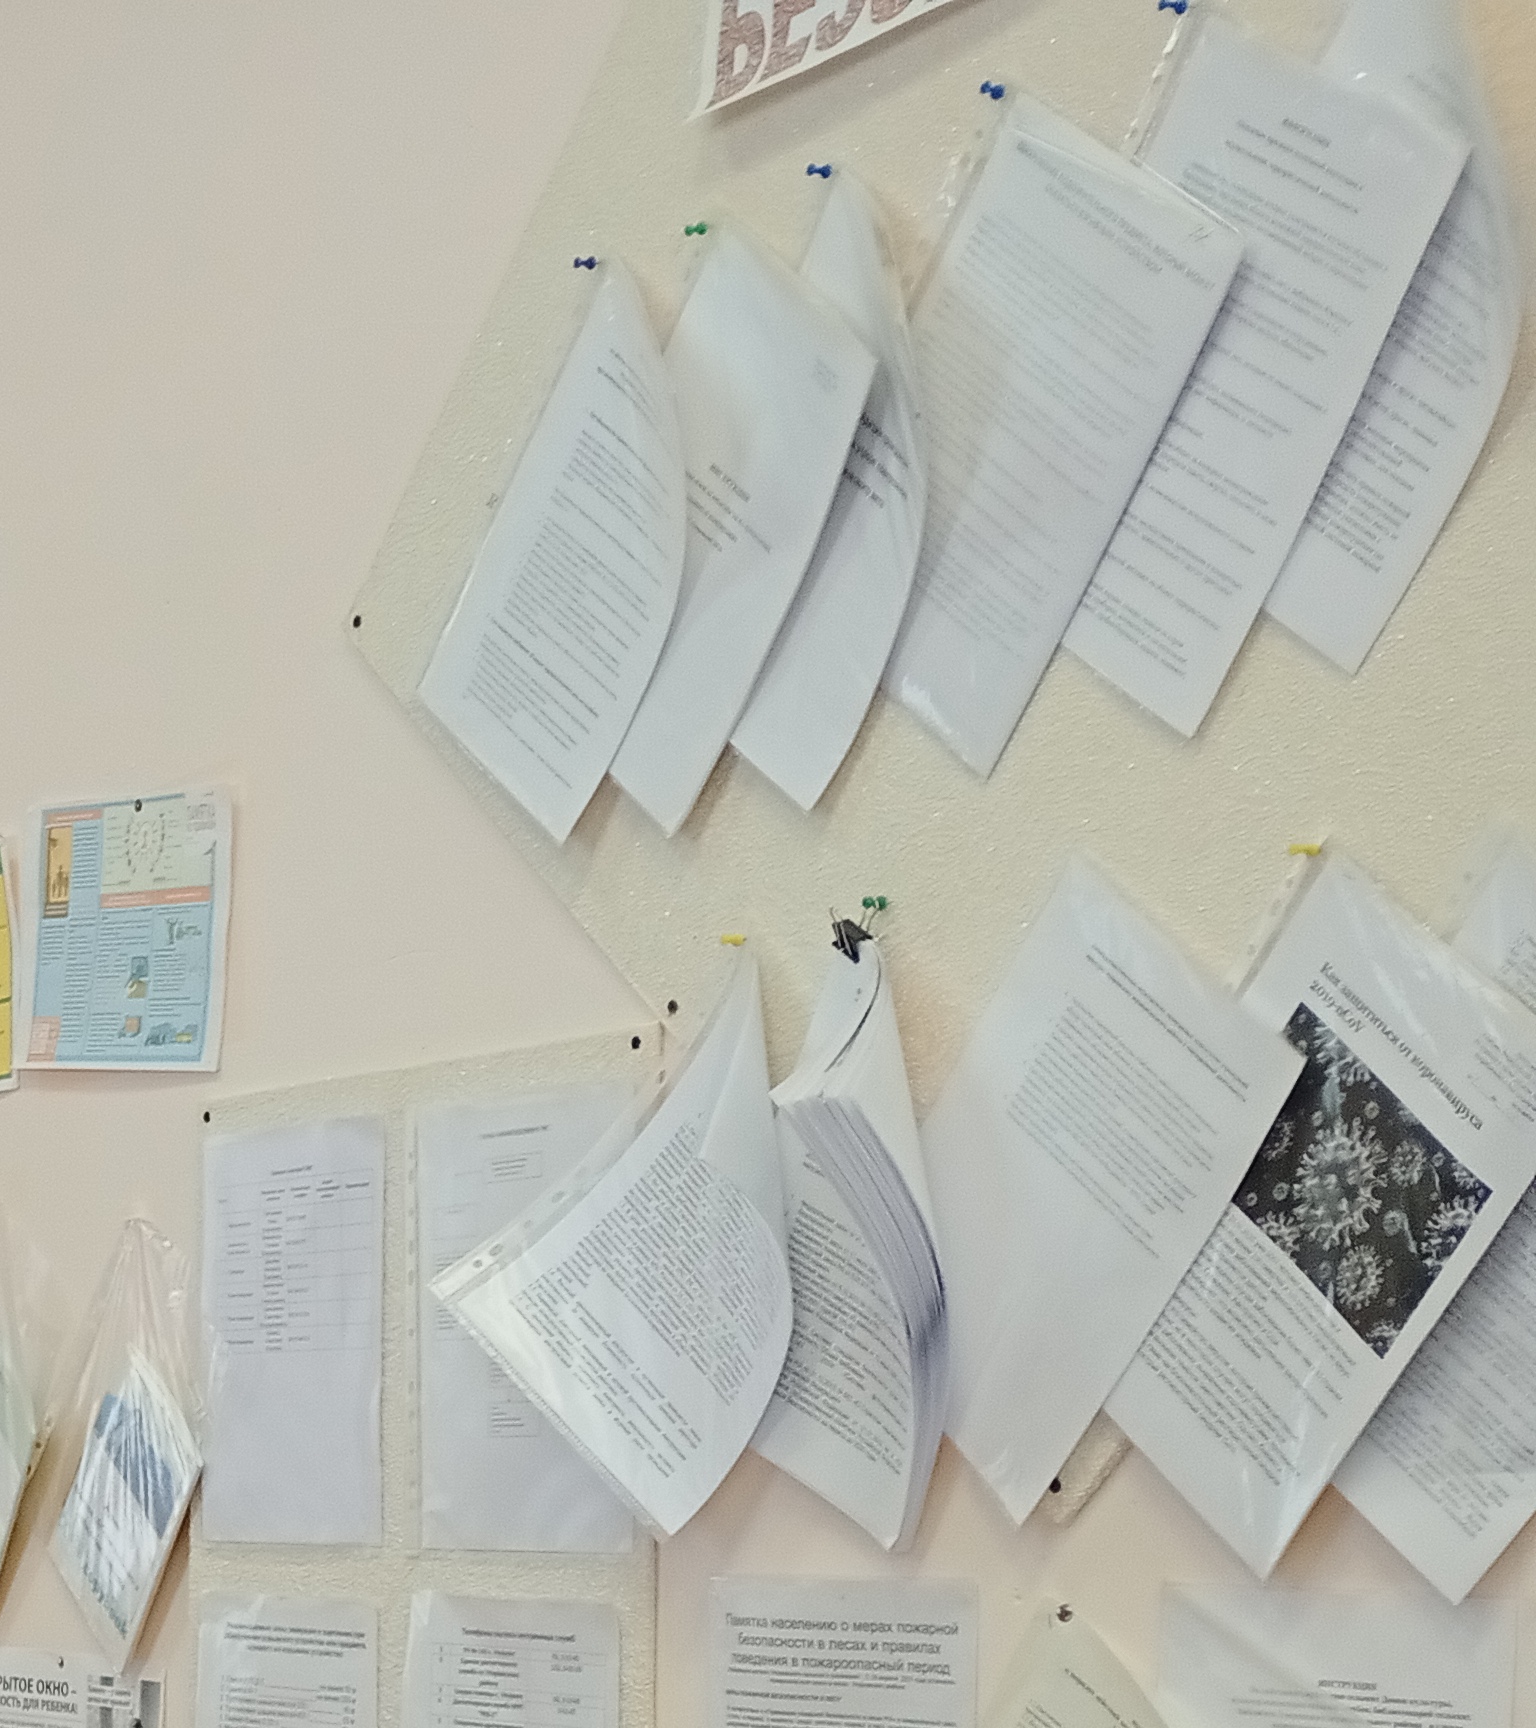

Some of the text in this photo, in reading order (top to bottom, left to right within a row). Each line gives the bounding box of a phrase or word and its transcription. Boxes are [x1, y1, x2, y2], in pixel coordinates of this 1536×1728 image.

[726, 1613, 768, 1628] Памятка
[771, 1618, 837, 1631] населению
[853, 1622, 893, 1634] мерах
[897, 1622, 959, 1636] пожарной
[738, 1632, 814, 1649] безопасности
[829, 1640, 867, 1651] лесах
[882, 1641, 941, 1654] правилах
[732, 1652, 788, 1667] поведения
[802, 1656, 903, 1673] пожароопасный
[907, 1661, 950, 1676] период
[36, 1679, 69, 1697] ОКНО
[22, 1697, 39, 1711] ДЛЯ
